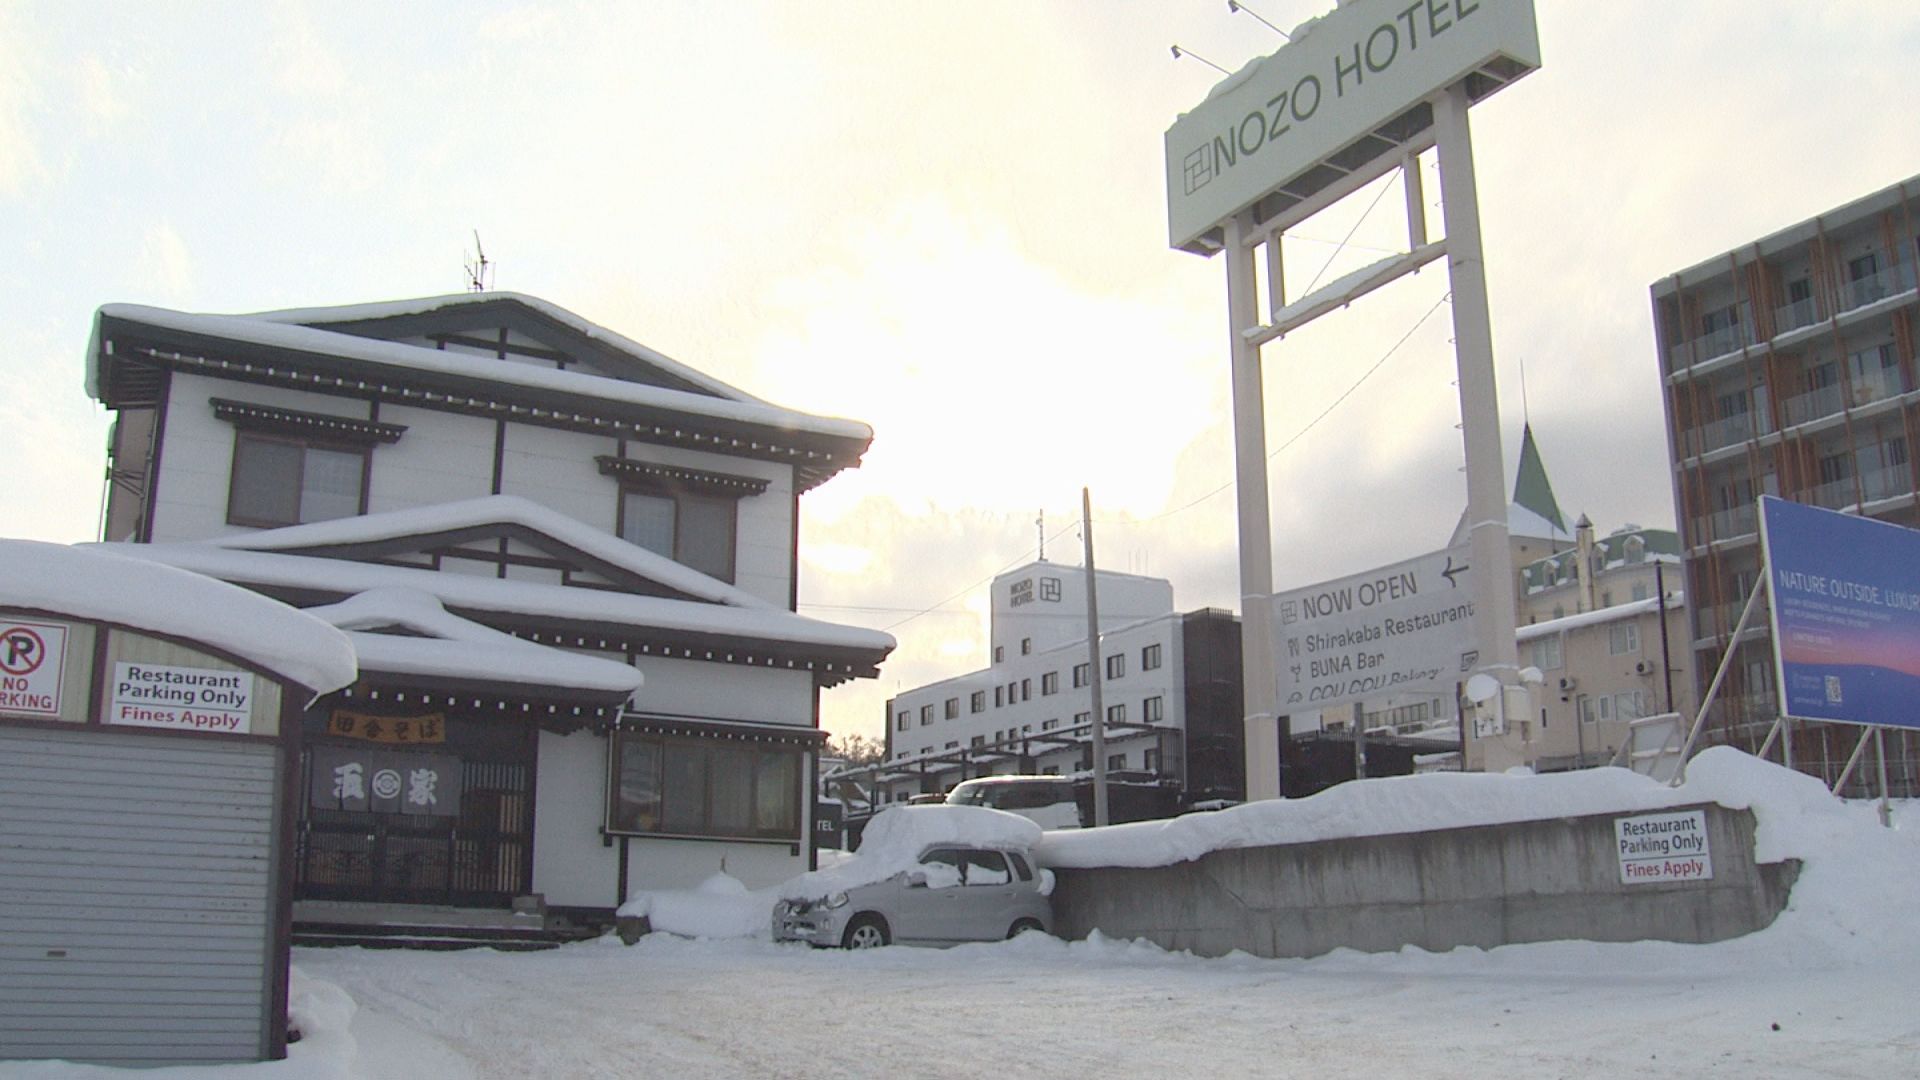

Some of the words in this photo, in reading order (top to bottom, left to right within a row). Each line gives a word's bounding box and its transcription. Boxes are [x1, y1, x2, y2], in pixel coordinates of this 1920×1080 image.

[1212, 74, 1322, 177] NOZO
[1779, 569, 1828, 595] NATURE
[1302, 587, 1352, 621] NOW
[1358, 571, 1418, 607] OPEN
[1306, 625, 1381, 653] Shirakaba
[1385, 601, 1476, 638] Restaurant
[127, 666, 241, 689] Restaurant
[1311, 655, 1353, 679] BUNA
[1357, 651, 1385, 670] Bar
[3, 677, 29, 691] NO
[119, 682, 196, 705] Parking
[201, 689, 247, 709] Only
[121, 706, 175, 722] Fines
[180, 711, 241, 730] Apply
[1623, 817, 1697, 836] Restaurant
[1620, 837, 1669, 854] Parking
[1672, 832, 1704, 852] Only
[1626, 863, 1661, 878] Fines
[1663, 858, 1704, 878] Apply
